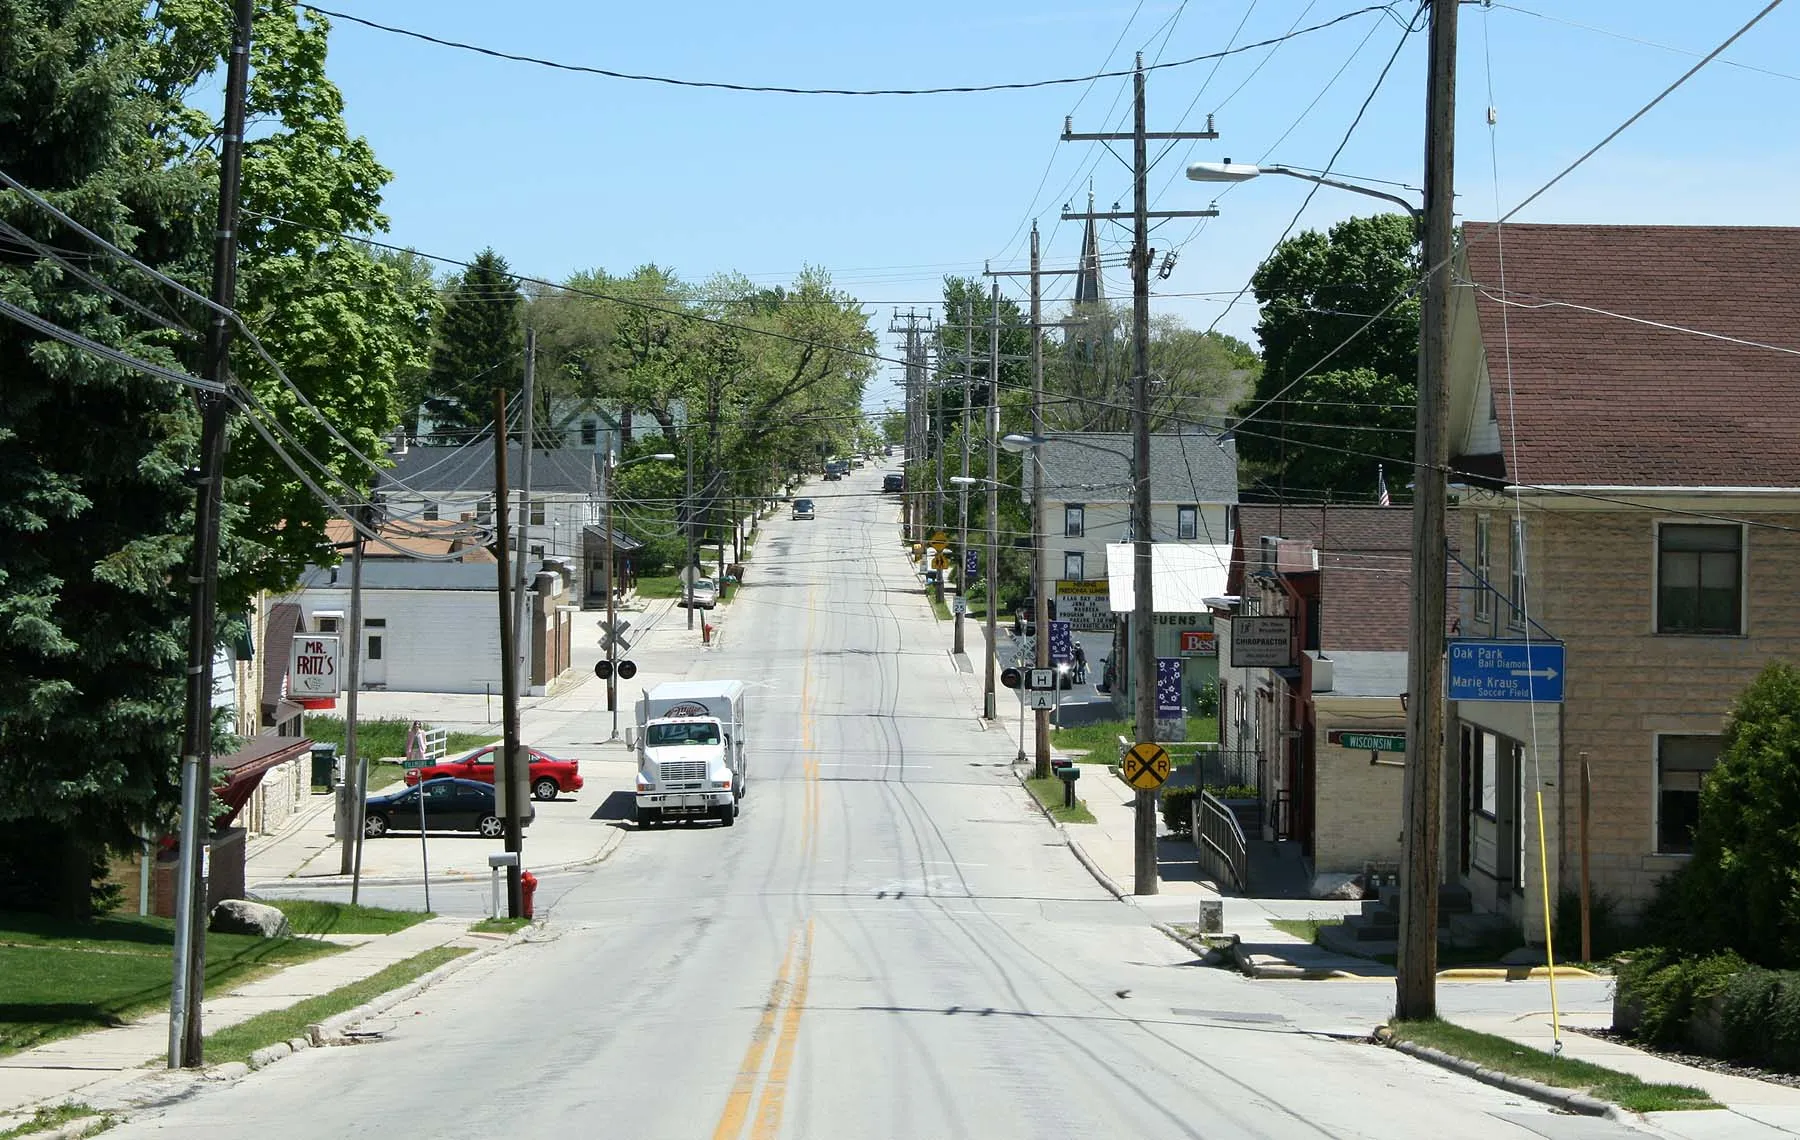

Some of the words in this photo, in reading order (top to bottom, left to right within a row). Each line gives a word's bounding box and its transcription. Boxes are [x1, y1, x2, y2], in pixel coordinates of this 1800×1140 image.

[954, 604, 965, 612] 25
[304, 641, 327, 654] MR.
[1235, 638, 1287, 646] CHIROPRACTOR
[1453, 647, 1473, 658] Oak
[1478, 647, 1503, 659] Park
[296, 655, 334, 675] FRITZ'S
[1478, 660, 1494, 668] Ball
[1037, 675, 1047, 685] H
[1452, 676, 1482, 687] Marie
[1487, 676, 1518, 688] Kraus
[1478, 688, 1506, 697] Soccer
[1509, 688, 1529, 697] Field
[1037, 697, 1046, 706] A
[1349, 735, 1392, 750] WISCONSIN
[1127, 760, 1137, 772] R
[1158, 760, 1168, 772] R
